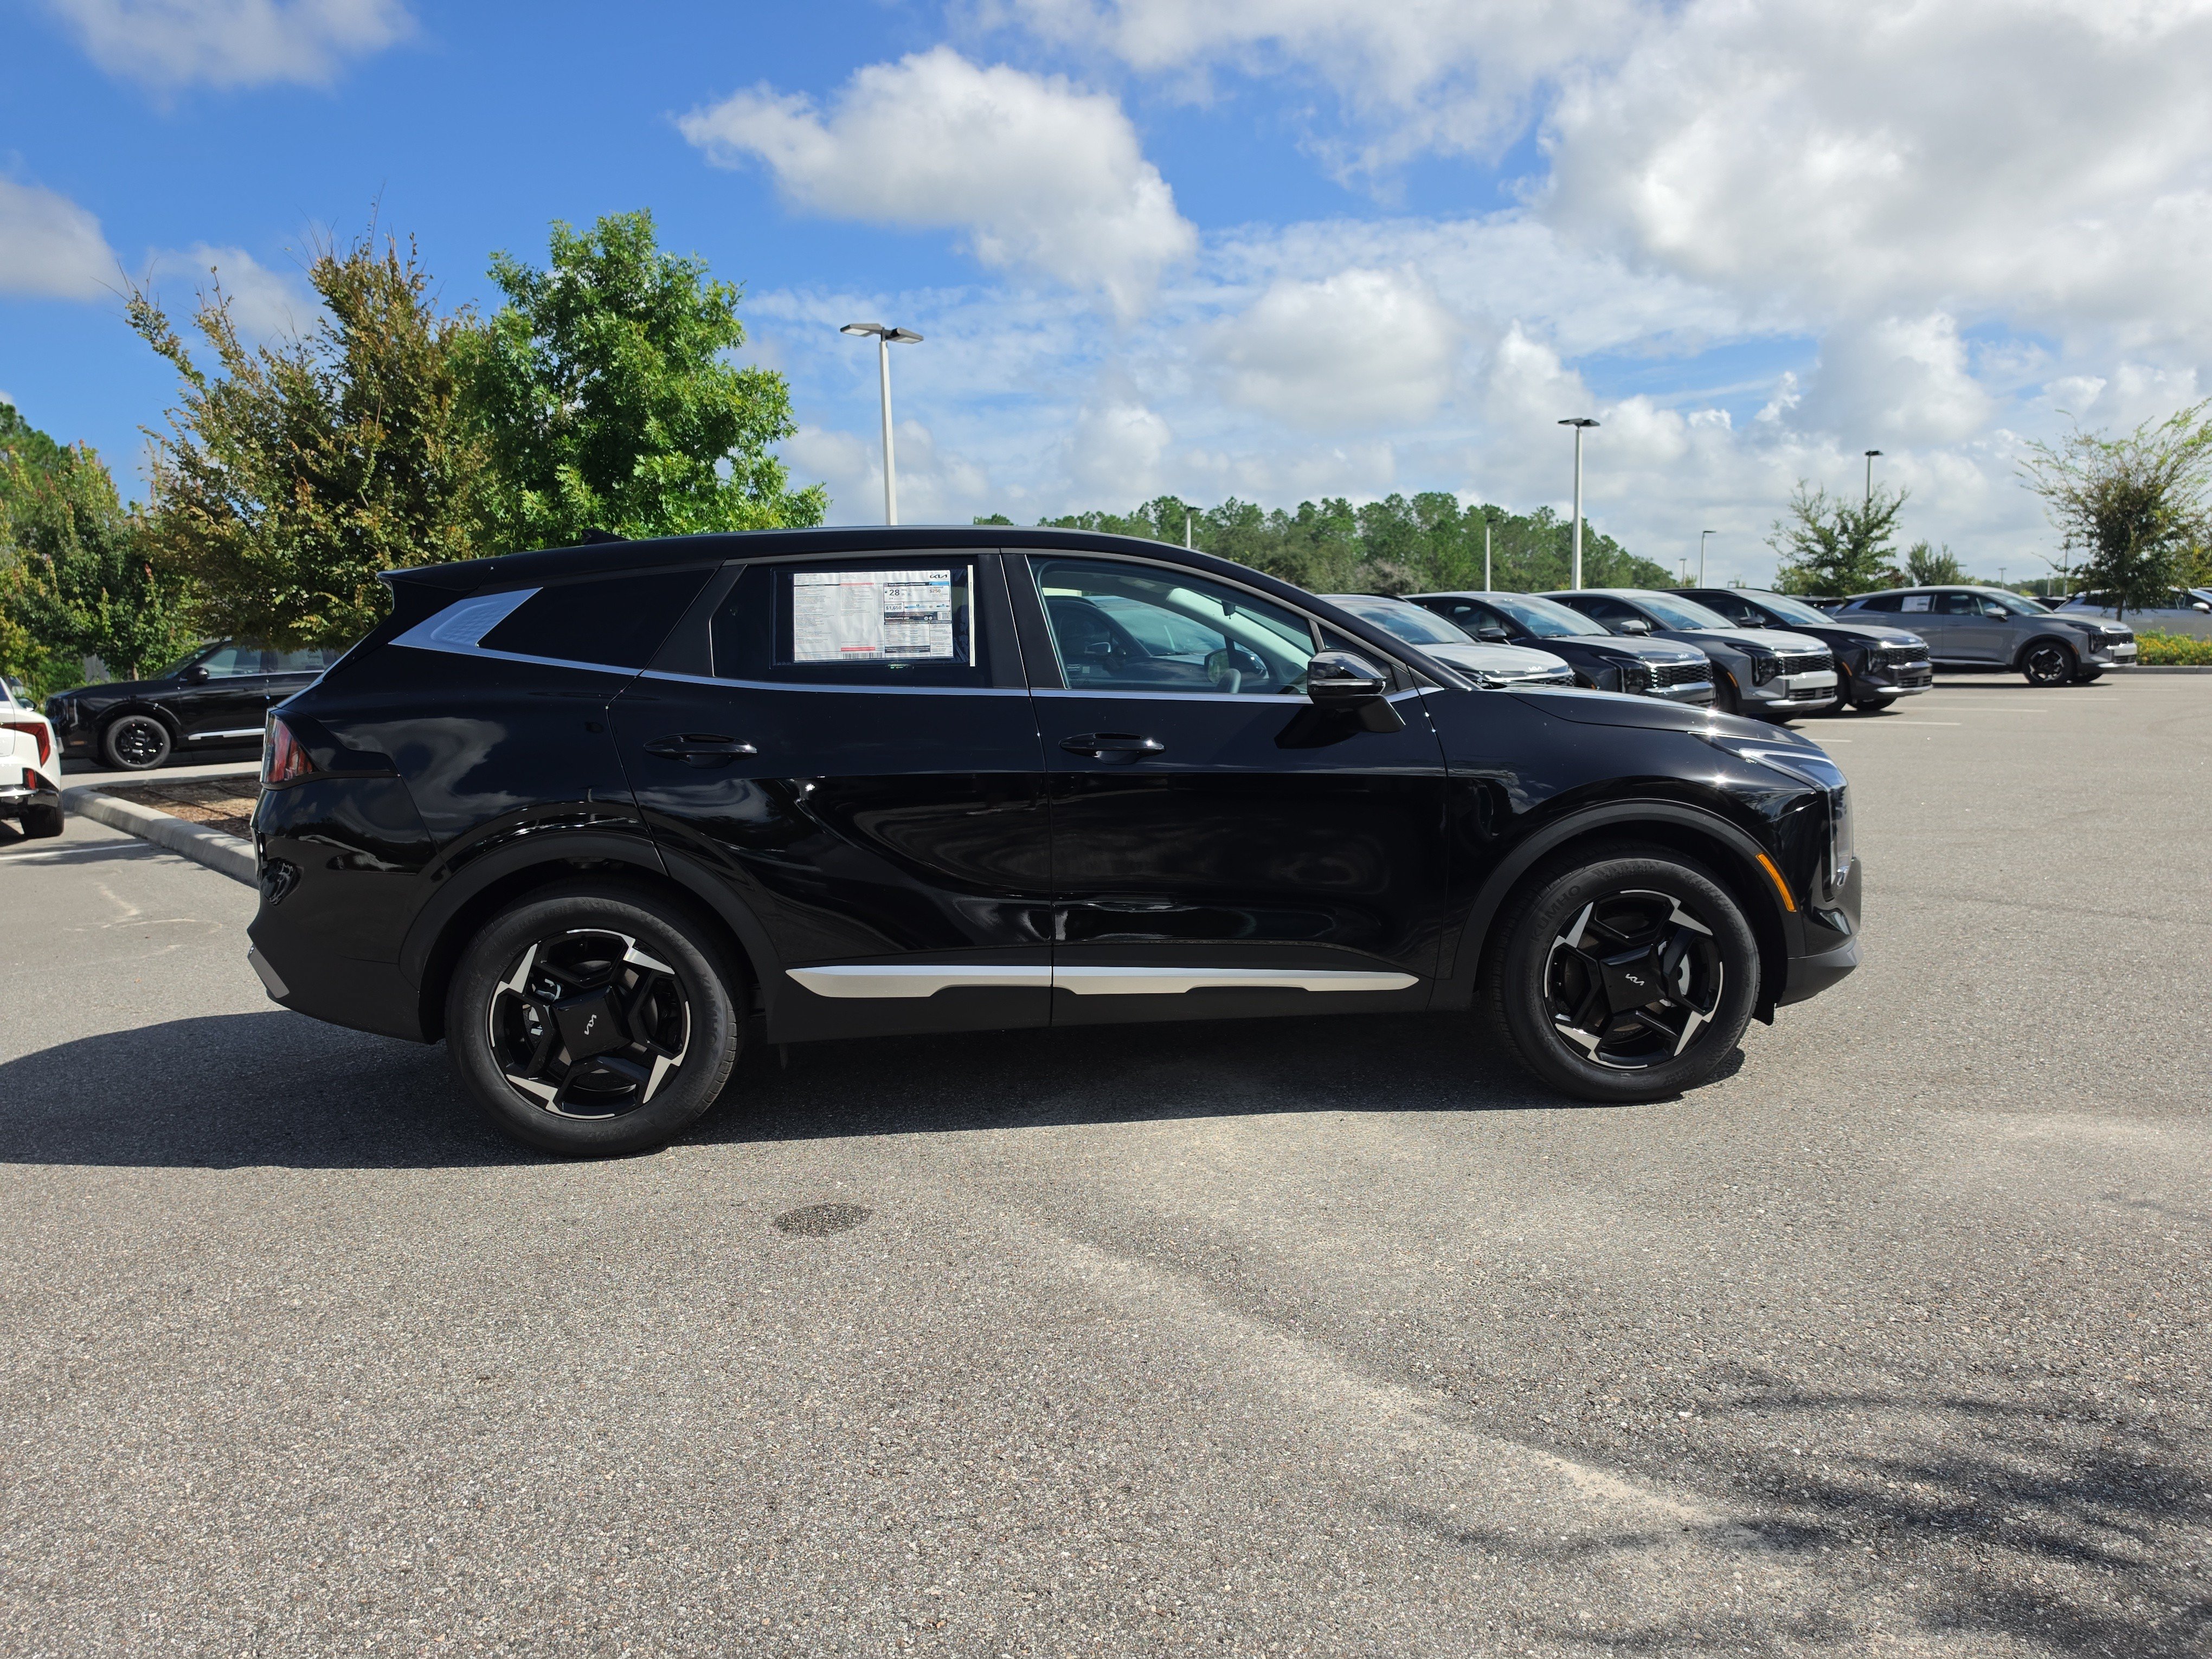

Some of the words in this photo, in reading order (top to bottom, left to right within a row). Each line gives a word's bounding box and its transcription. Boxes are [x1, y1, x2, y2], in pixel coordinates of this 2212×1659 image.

[1530, 885, 1581, 943] KUMHO
[1625, 973, 1645, 986] KIA
[584, 1014, 597, 1035] KIA
